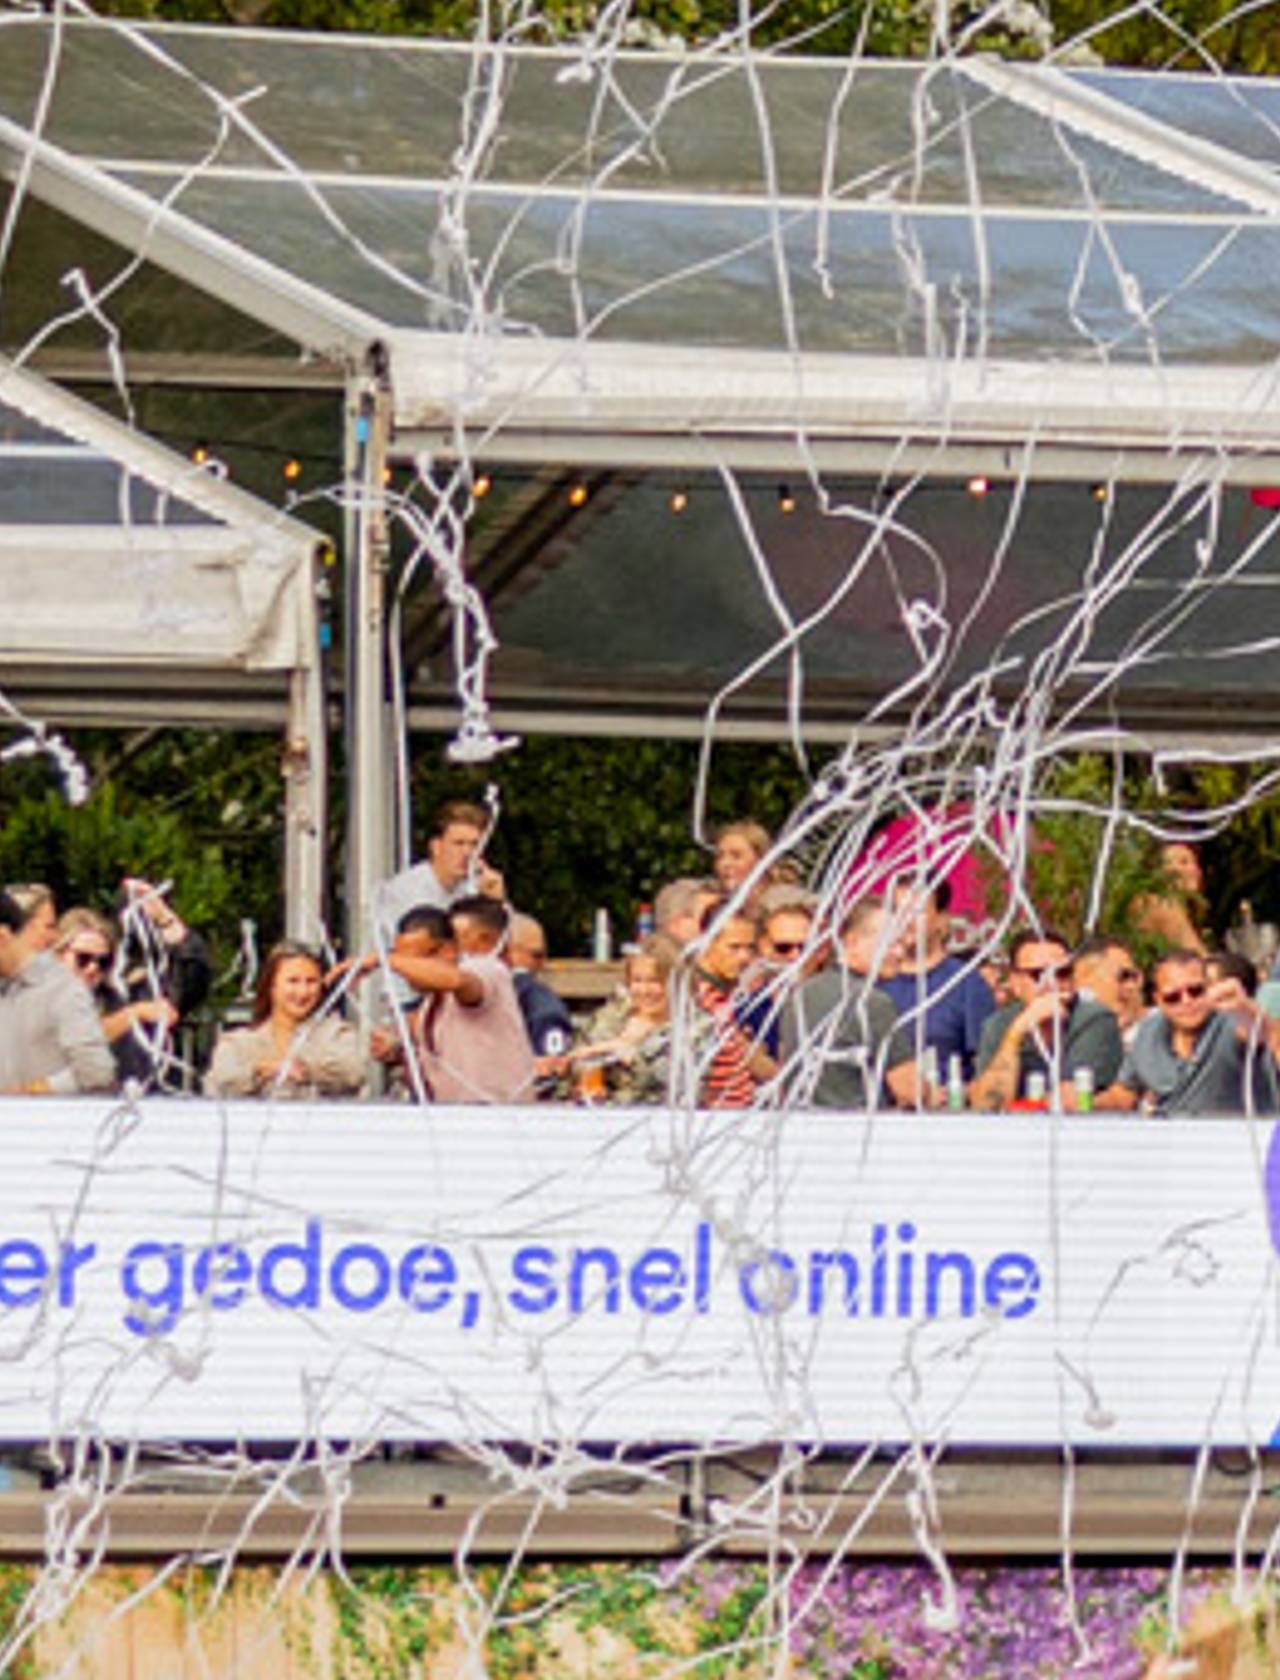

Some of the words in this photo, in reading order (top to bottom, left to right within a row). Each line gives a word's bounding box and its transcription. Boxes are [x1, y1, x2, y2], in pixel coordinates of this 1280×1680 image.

[120, 1218, 481, 1337] gedoe,
[508, 1221, 712, 1316] snel
[738, 1222, 1042, 1319] online
